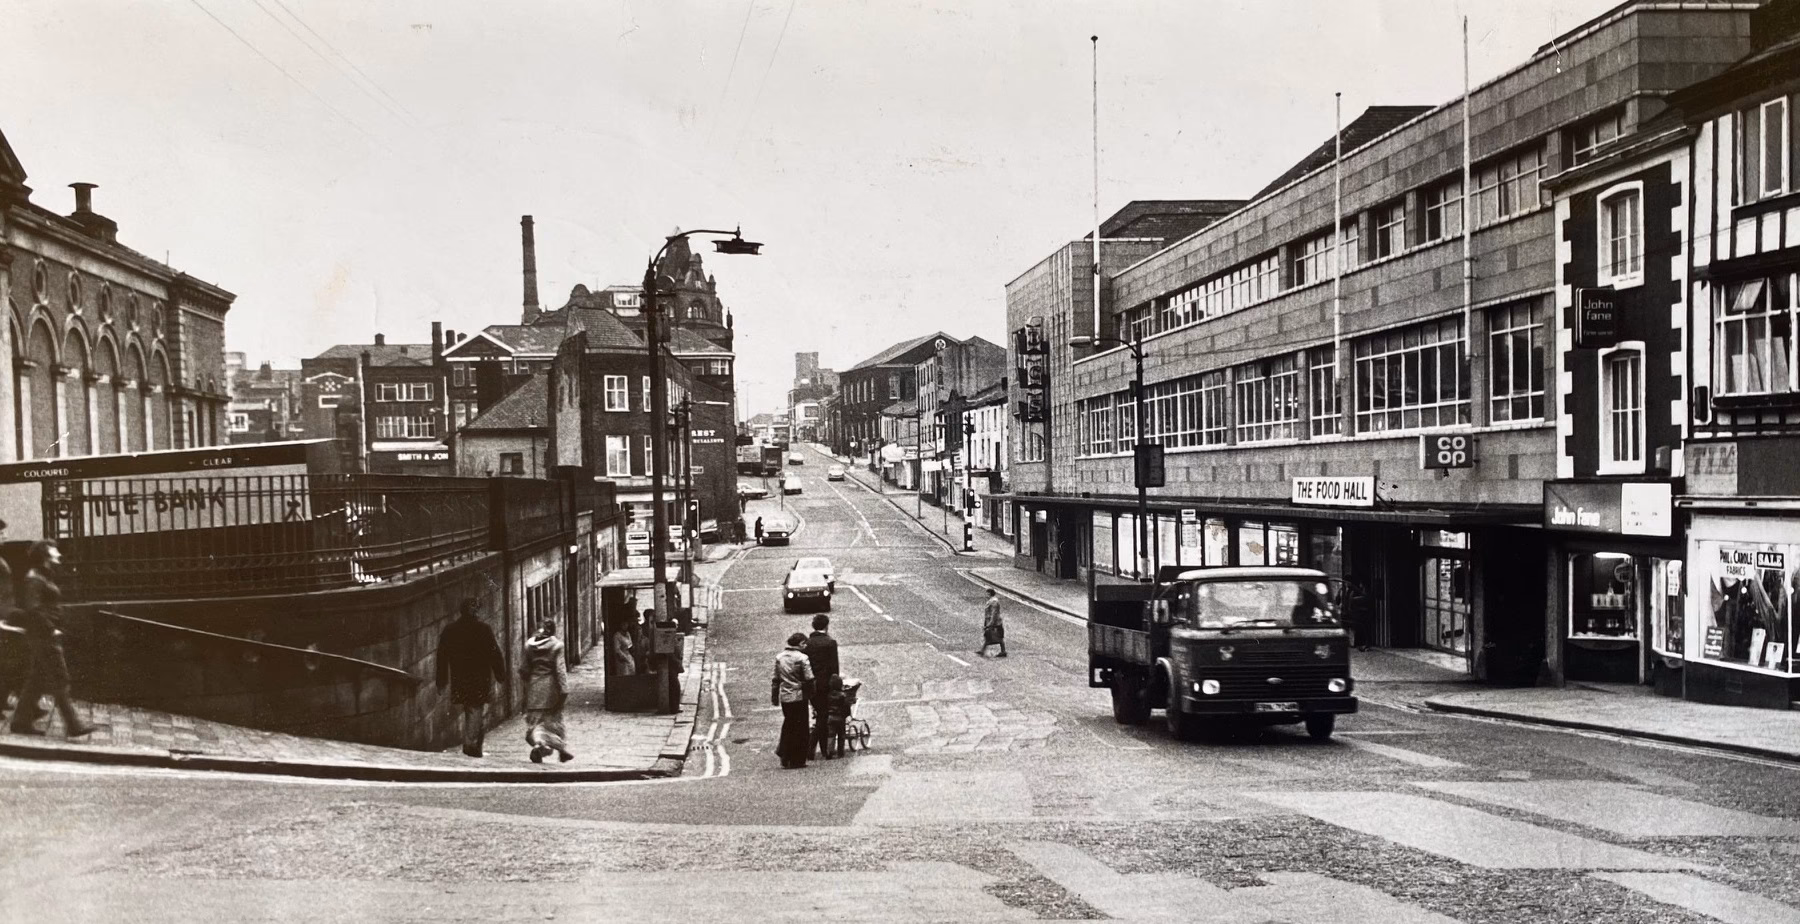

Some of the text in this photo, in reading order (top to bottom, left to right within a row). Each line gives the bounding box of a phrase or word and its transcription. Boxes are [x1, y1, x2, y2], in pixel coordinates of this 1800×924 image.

[1584, 299, 1614, 310] John
[1586, 310, 1612, 321] fane
[202, 457, 233, 467] CLEAR
[398, 453, 422, 461] SMITH
[23, 467, 70, 478] COLOURED
[1297, 481, 1368, 501] THE FOOD HALL
[154, 486, 225, 514] BANK
[1551, 505, 1576, 526] John
[1758, 553, 1782, 567] SALE
[1726, 565, 1746, 576] FABRICS
